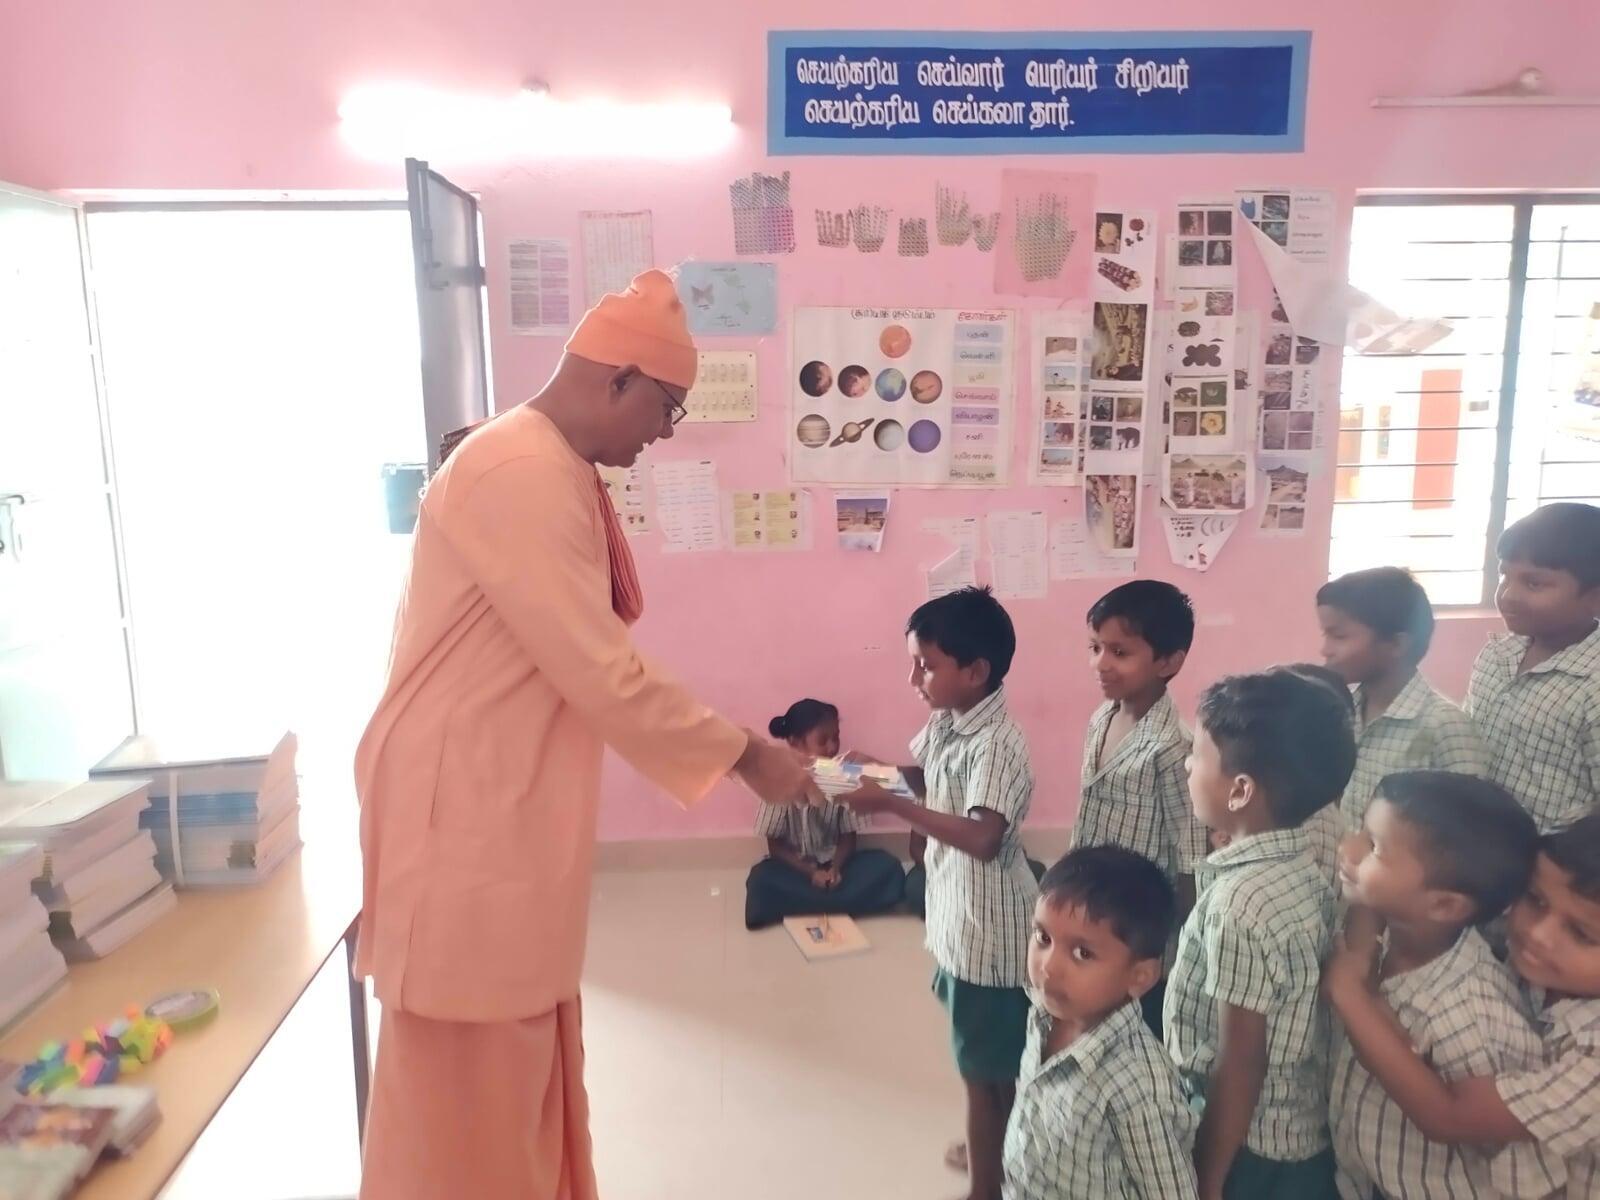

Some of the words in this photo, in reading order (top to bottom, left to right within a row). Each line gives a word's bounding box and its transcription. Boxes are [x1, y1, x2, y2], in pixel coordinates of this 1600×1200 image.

[796, 54, 900, 91] செயற்கரிய
[917, 55, 1005, 92] செய்வார்
[1025, 56, 1099, 95] பெரியர்
[1115, 57, 1190, 96] சிறியர்
[804, 93, 921, 130] செயற்கரிய
